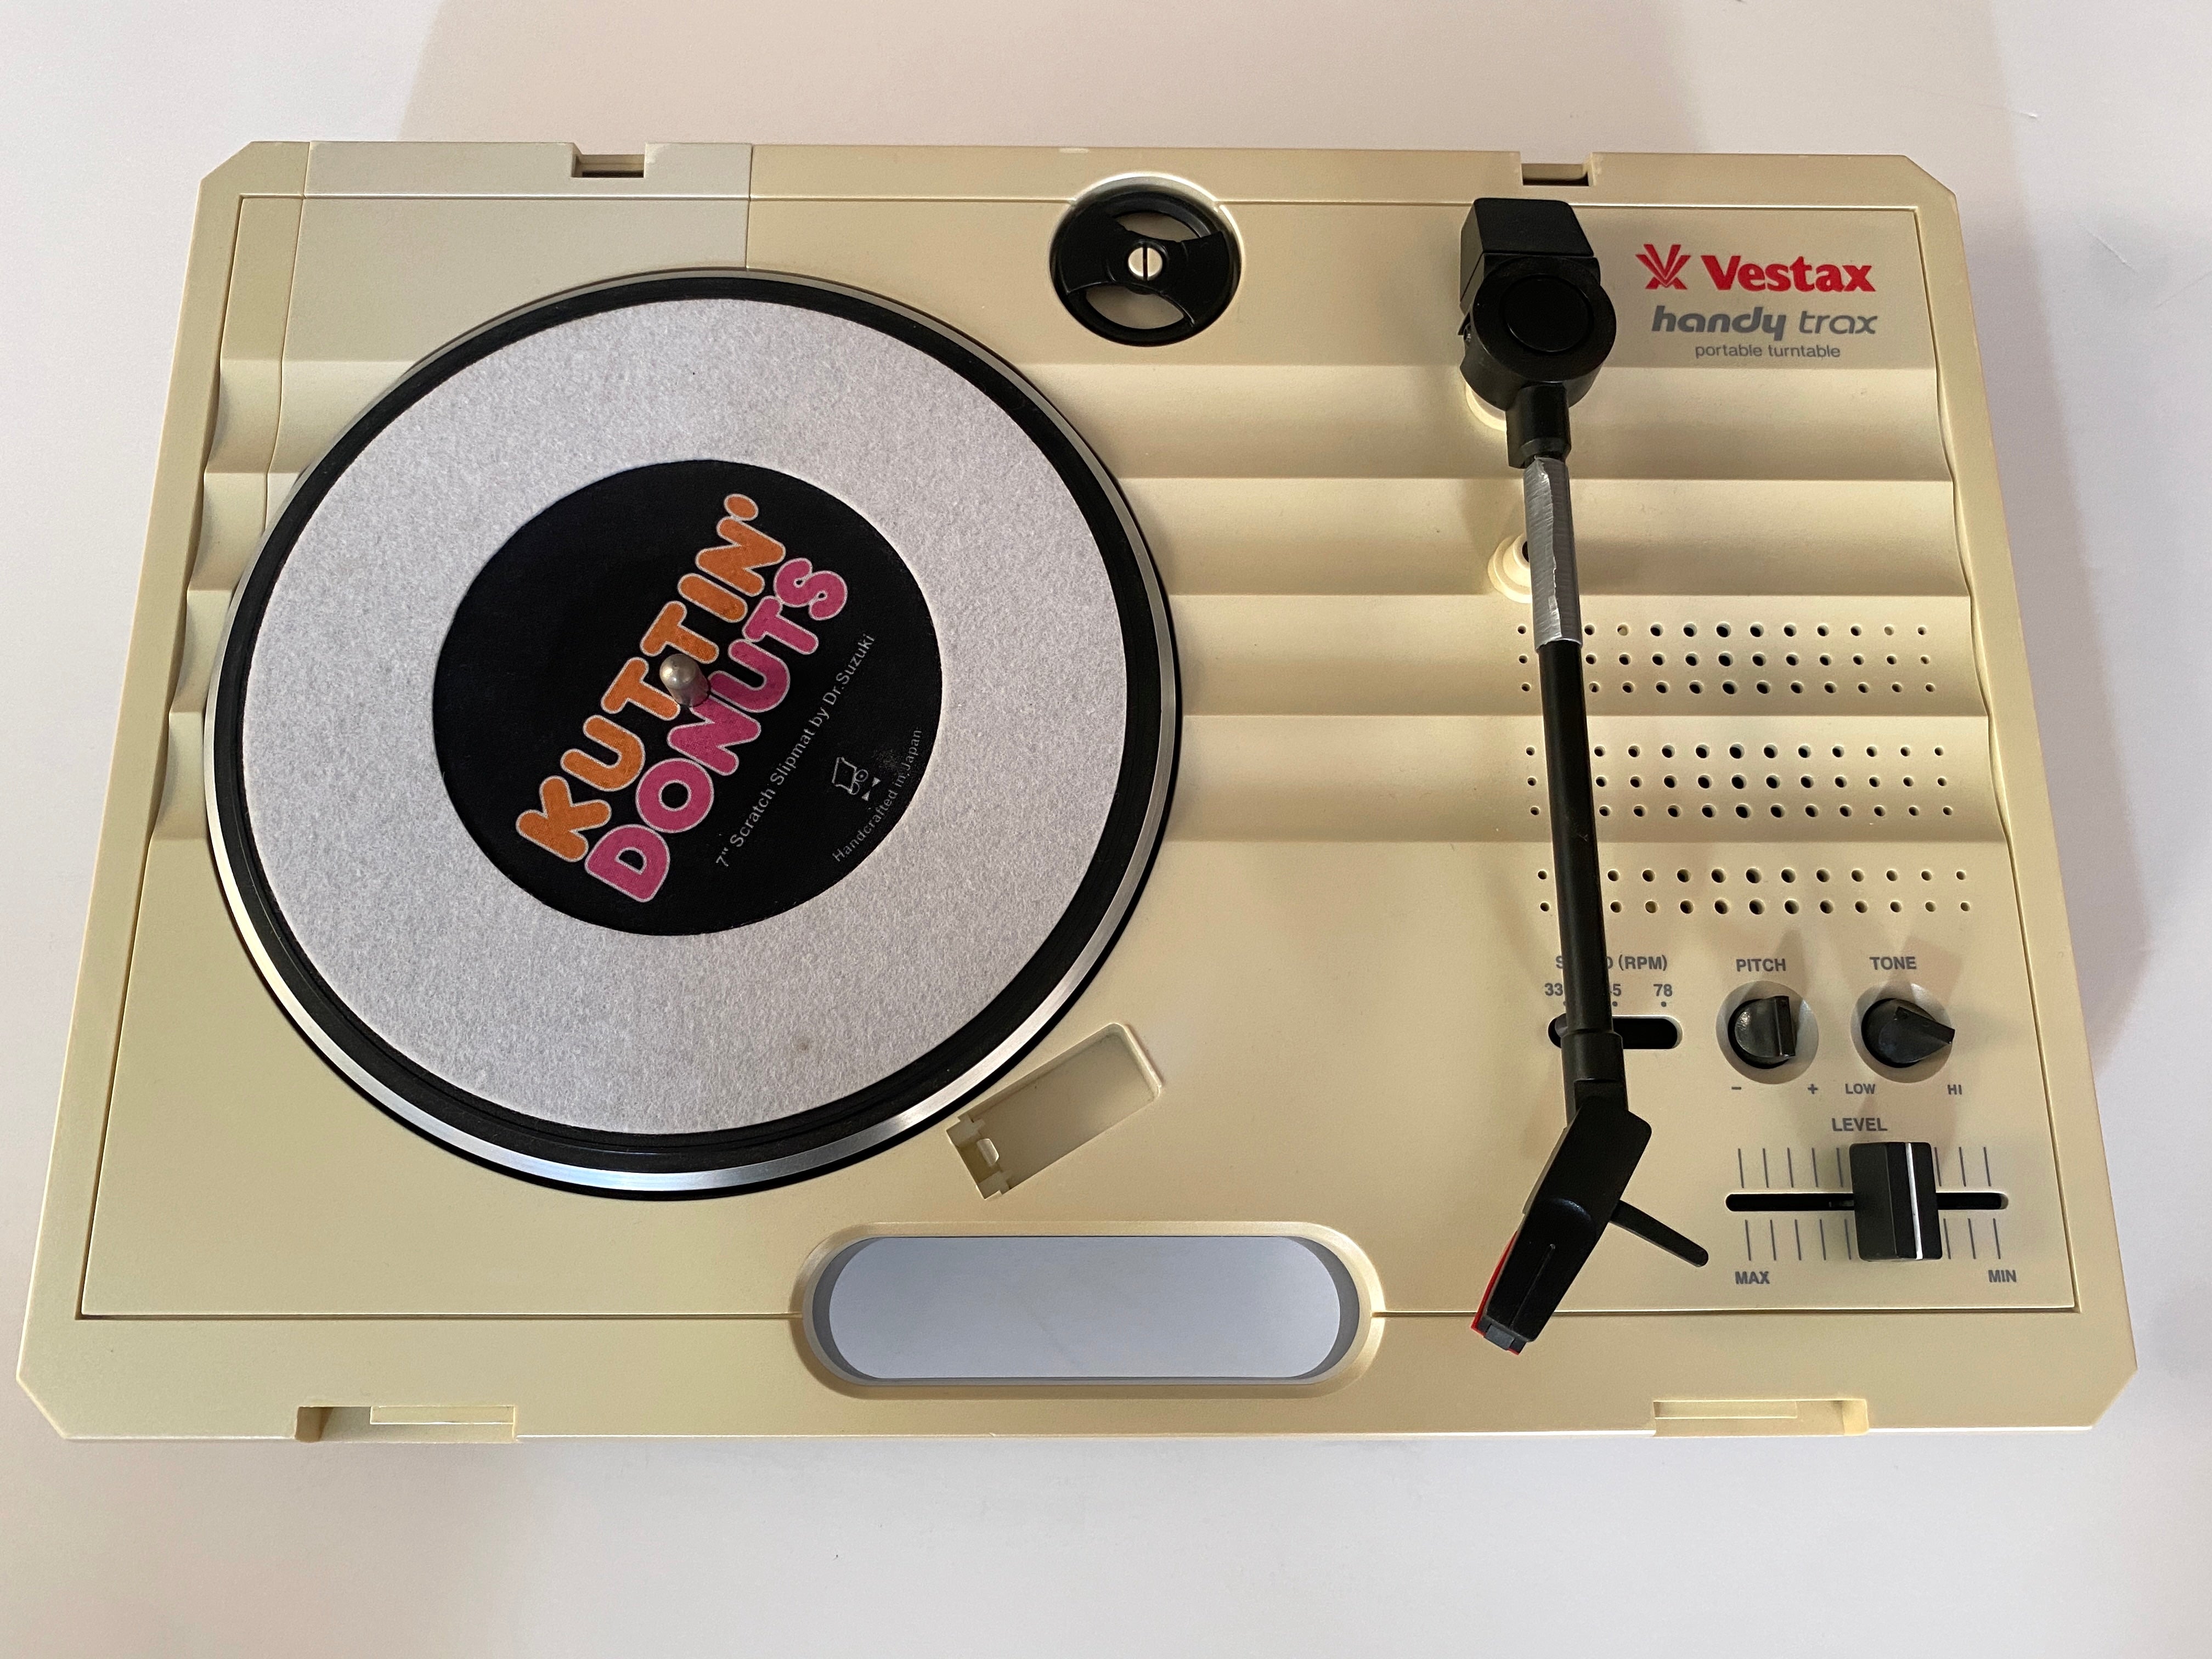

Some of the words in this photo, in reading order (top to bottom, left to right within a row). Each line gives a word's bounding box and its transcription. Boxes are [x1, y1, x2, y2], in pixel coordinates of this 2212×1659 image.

[1701, 255, 1876, 292] Vestax
[1651, 305, 1786, 341] handy
[1799, 311, 1877, 335] trax
[1695, 344, 1762, 358] portable
[1768, 345, 1841, 358] turntable
[584, 558, 848, 902] DONUTS
[730, 788, 776, 847] Scratch
[770, 727, 816, 786] Slipmat
[809, 707, 830, 729] by
[832, 790, 898, 862] Handcrafted
[901, 729, 922, 771] Japan
[1618, 955, 1668, 971] (RPM)
[1736, 958, 1786, 972] PITCH
[1869, 956, 1917, 970] TONE
[1653, 984, 1673, 997] 78
[1845, 1084, 1876, 1094] LOW
[1947, 1085, 1962, 1095] HI
[1832, 1118, 1888, 1132] LEVEL
[1735, 1271, 1770, 1285] MAX
[1988, 1269, 2017, 1283] MIN
